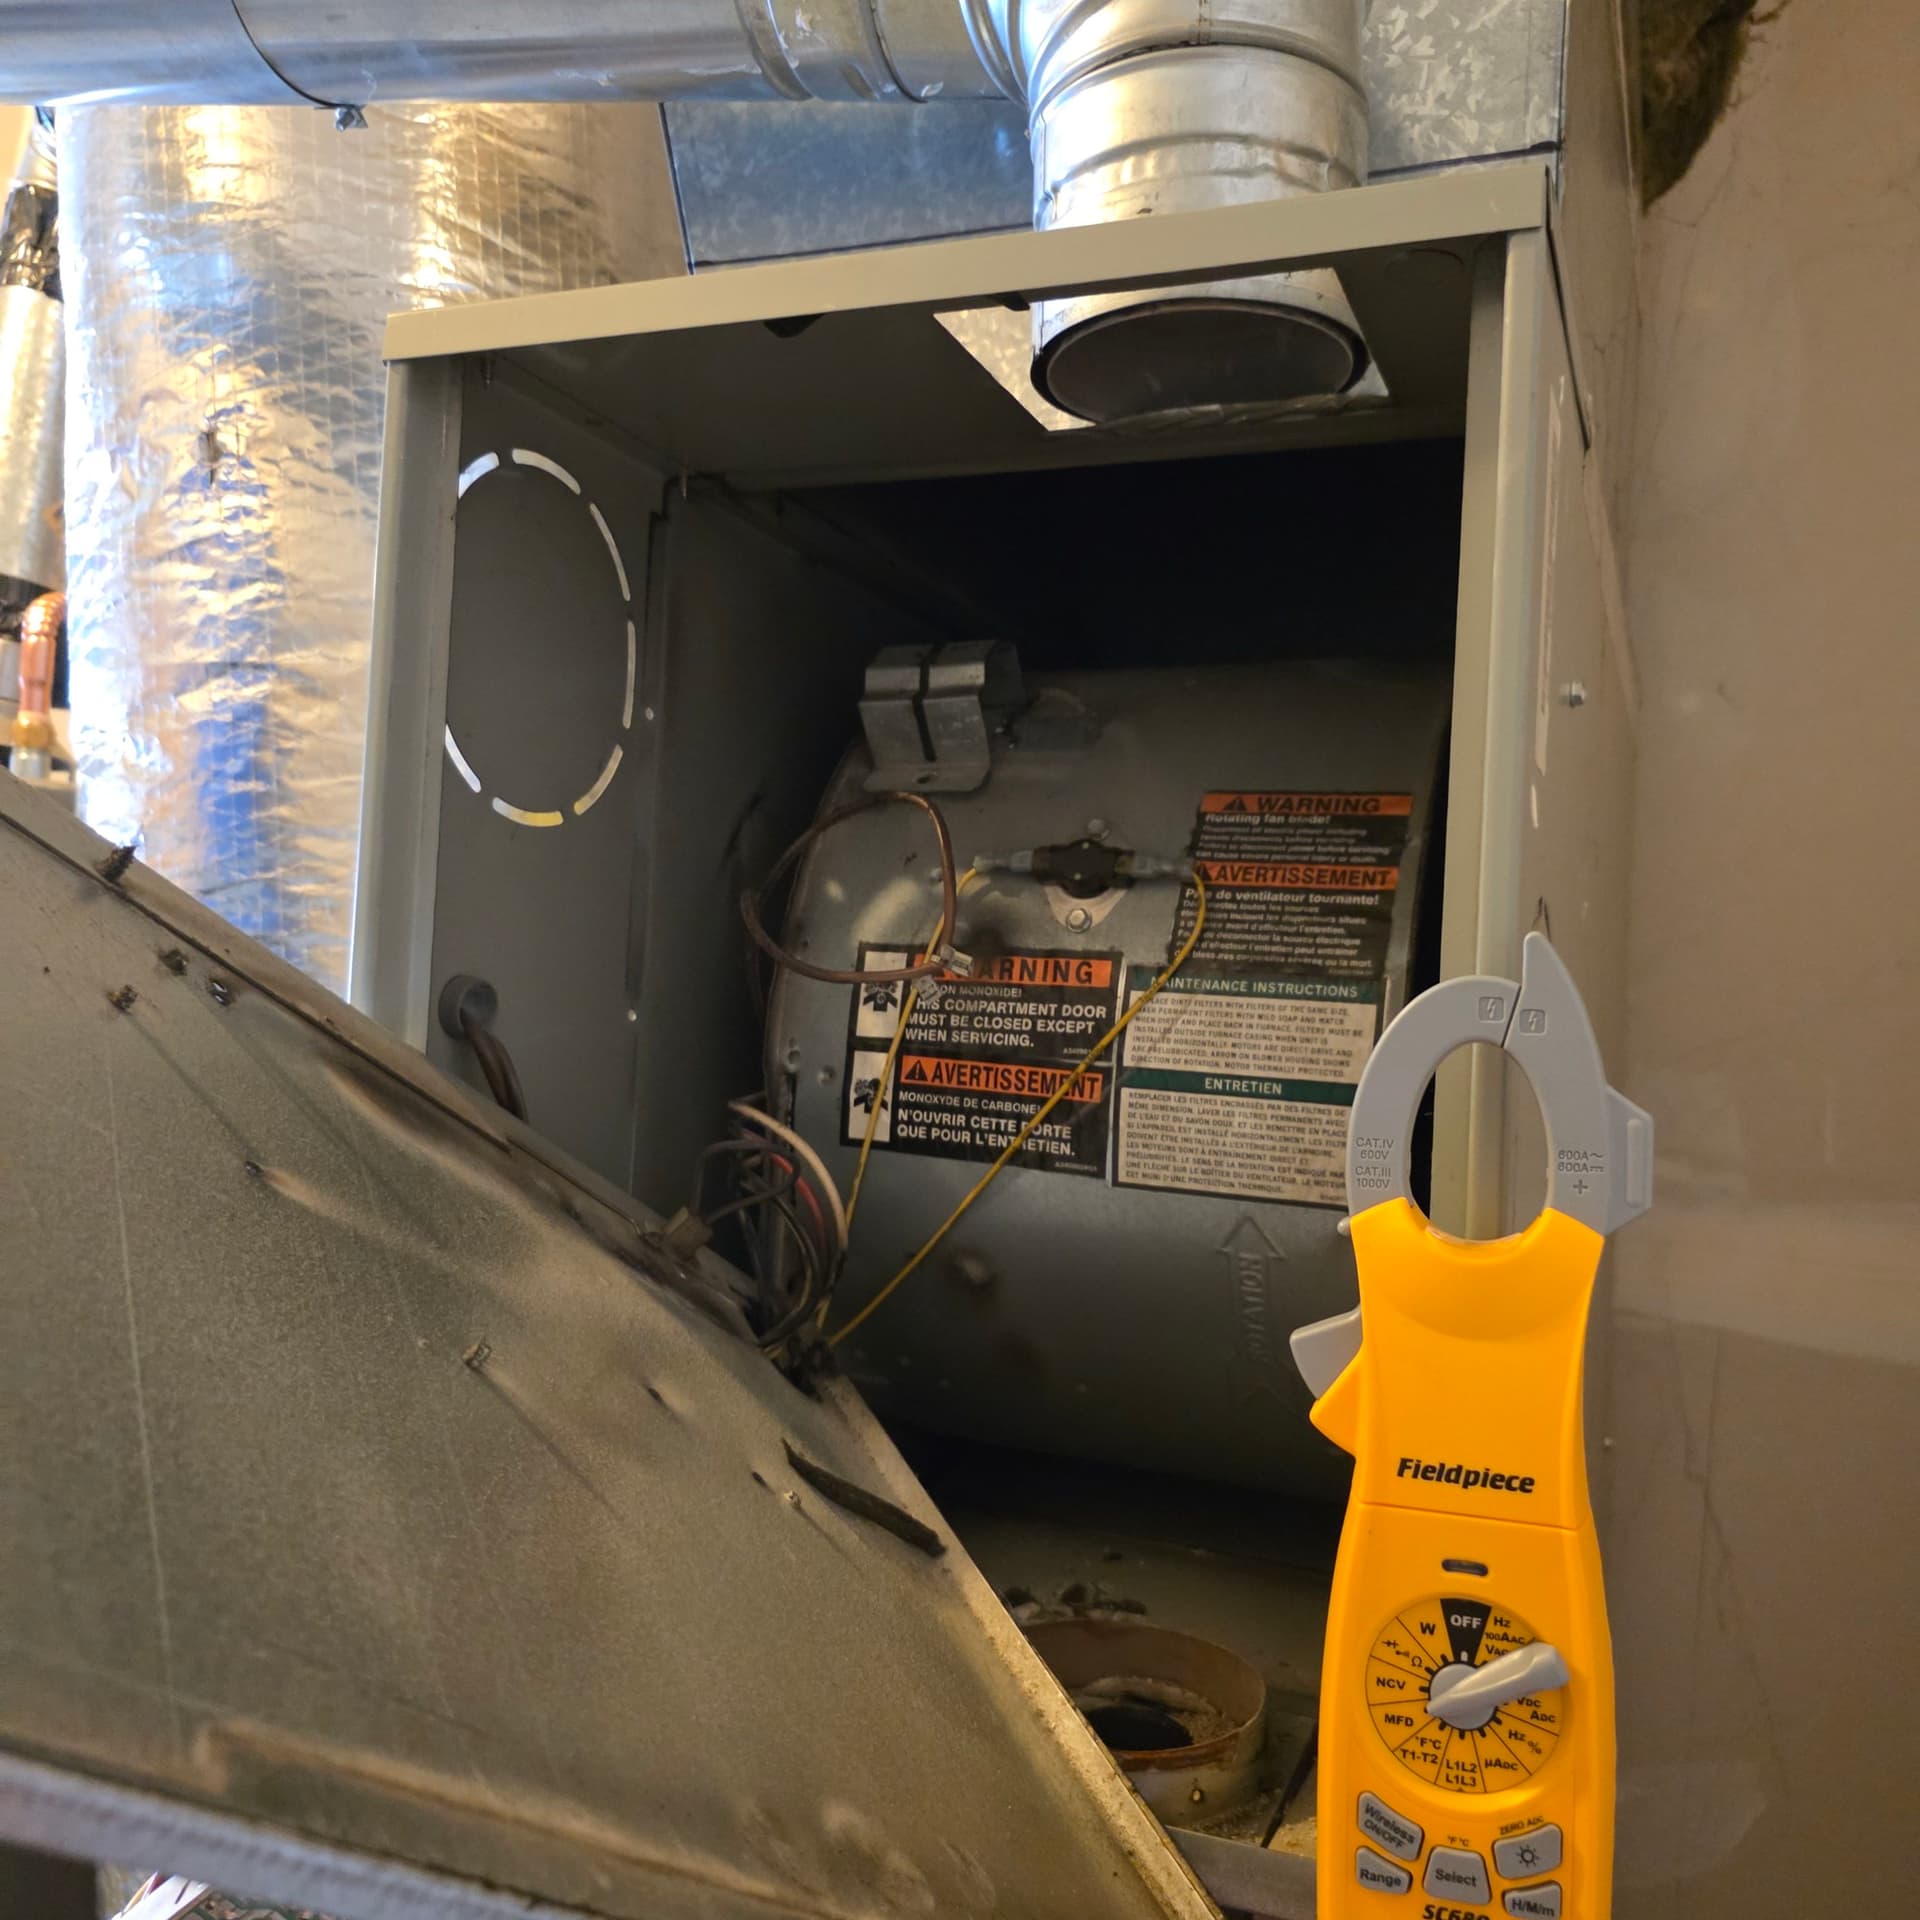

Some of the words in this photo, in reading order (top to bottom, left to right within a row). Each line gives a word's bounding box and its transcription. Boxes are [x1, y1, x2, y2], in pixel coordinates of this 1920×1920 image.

[1257, 797, 1380, 812] WARNING
[1205, 814, 1260, 824] Rotating
[1264, 814, 1284, 823] fan
[1215, 864, 1390, 886] AVERTISSEMENT
[1216, 890, 1232, 900] de
[1236, 890, 1305, 903] ventilateur
[1309, 894, 1379, 906] tournante!
[971, 956, 1093, 986] ARNING
[959, 986, 1022, 998] MONOXIDE!
[1252, 982, 1358, 998] INSTRUCTIONS
[914, 997, 940, 1010] HIS
[944, 1000, 1058, 1016] COMPARTMENT
[1062, 1004, 1106, 1019] DOOR
[908, 1012, 947, 1026] MUST
[950, 1014, 968, 1026] BE
[973, 1016, 1032, 1031] CLOSED
[1036, 1020, 1096, 1034] EXCEPT
[906, 1028, 948, 1042] WHEN
[951, 1030, 1034, 1048] SERVICING.
[1204, 1078, 1283, 1094] ENTRETIEN
[900, 1091, 960, 1106] MONOXYDE
[963, 1098, 979, 1109] DE
[982, 1100, 1040, 1114] CARBONE!
[898, 1108, 966, 1126] N'OUVRIR
[970, 1117, 1016, 1132] CETTE
[1021, 1121, 1072, 1139] PORTE
[897, 1124, 928, 1139] QUE
[931, 1128, 970, 1144] POUR
[1356, 1137, 1394, 1149] CAT.IV
[1360, 1150, 1390, 1160] 600V
[1355, 1166, 1390, 1176] CAT.III
[1356, 1178, 1390, 1188] 1000V
[1397, 1458, 1536, 1494] Fieldpiece
[1420, 1622, 1436, 1636] W
[1450, 1614, 1482, 1630] OFF
[1494, 1616, 1511, 1628] Hz
[1376, 1677, 1406, 1690] NCV
[1384, 1714, 1414, 1727] MFD
[1508, 1730, 1526, 1742] Hz
[1400, 1748, 1438, 1764] T1-T2
[1446, 1758, 1478, 1773] L1L2
[1446, 1773, 1477, 1787] L1L3
[1365, 1803, 1416, 1844] Wireless
[1500, 1821, 1525, 1836] ZERO
[1364, 1818, 1404, 1849] ON/OFF
[1360, 1868, 1402, 1888] Range
[1435, 1868, 1478, 1888] Select
[1512, 1899, 1555, 1916] H/M/m
